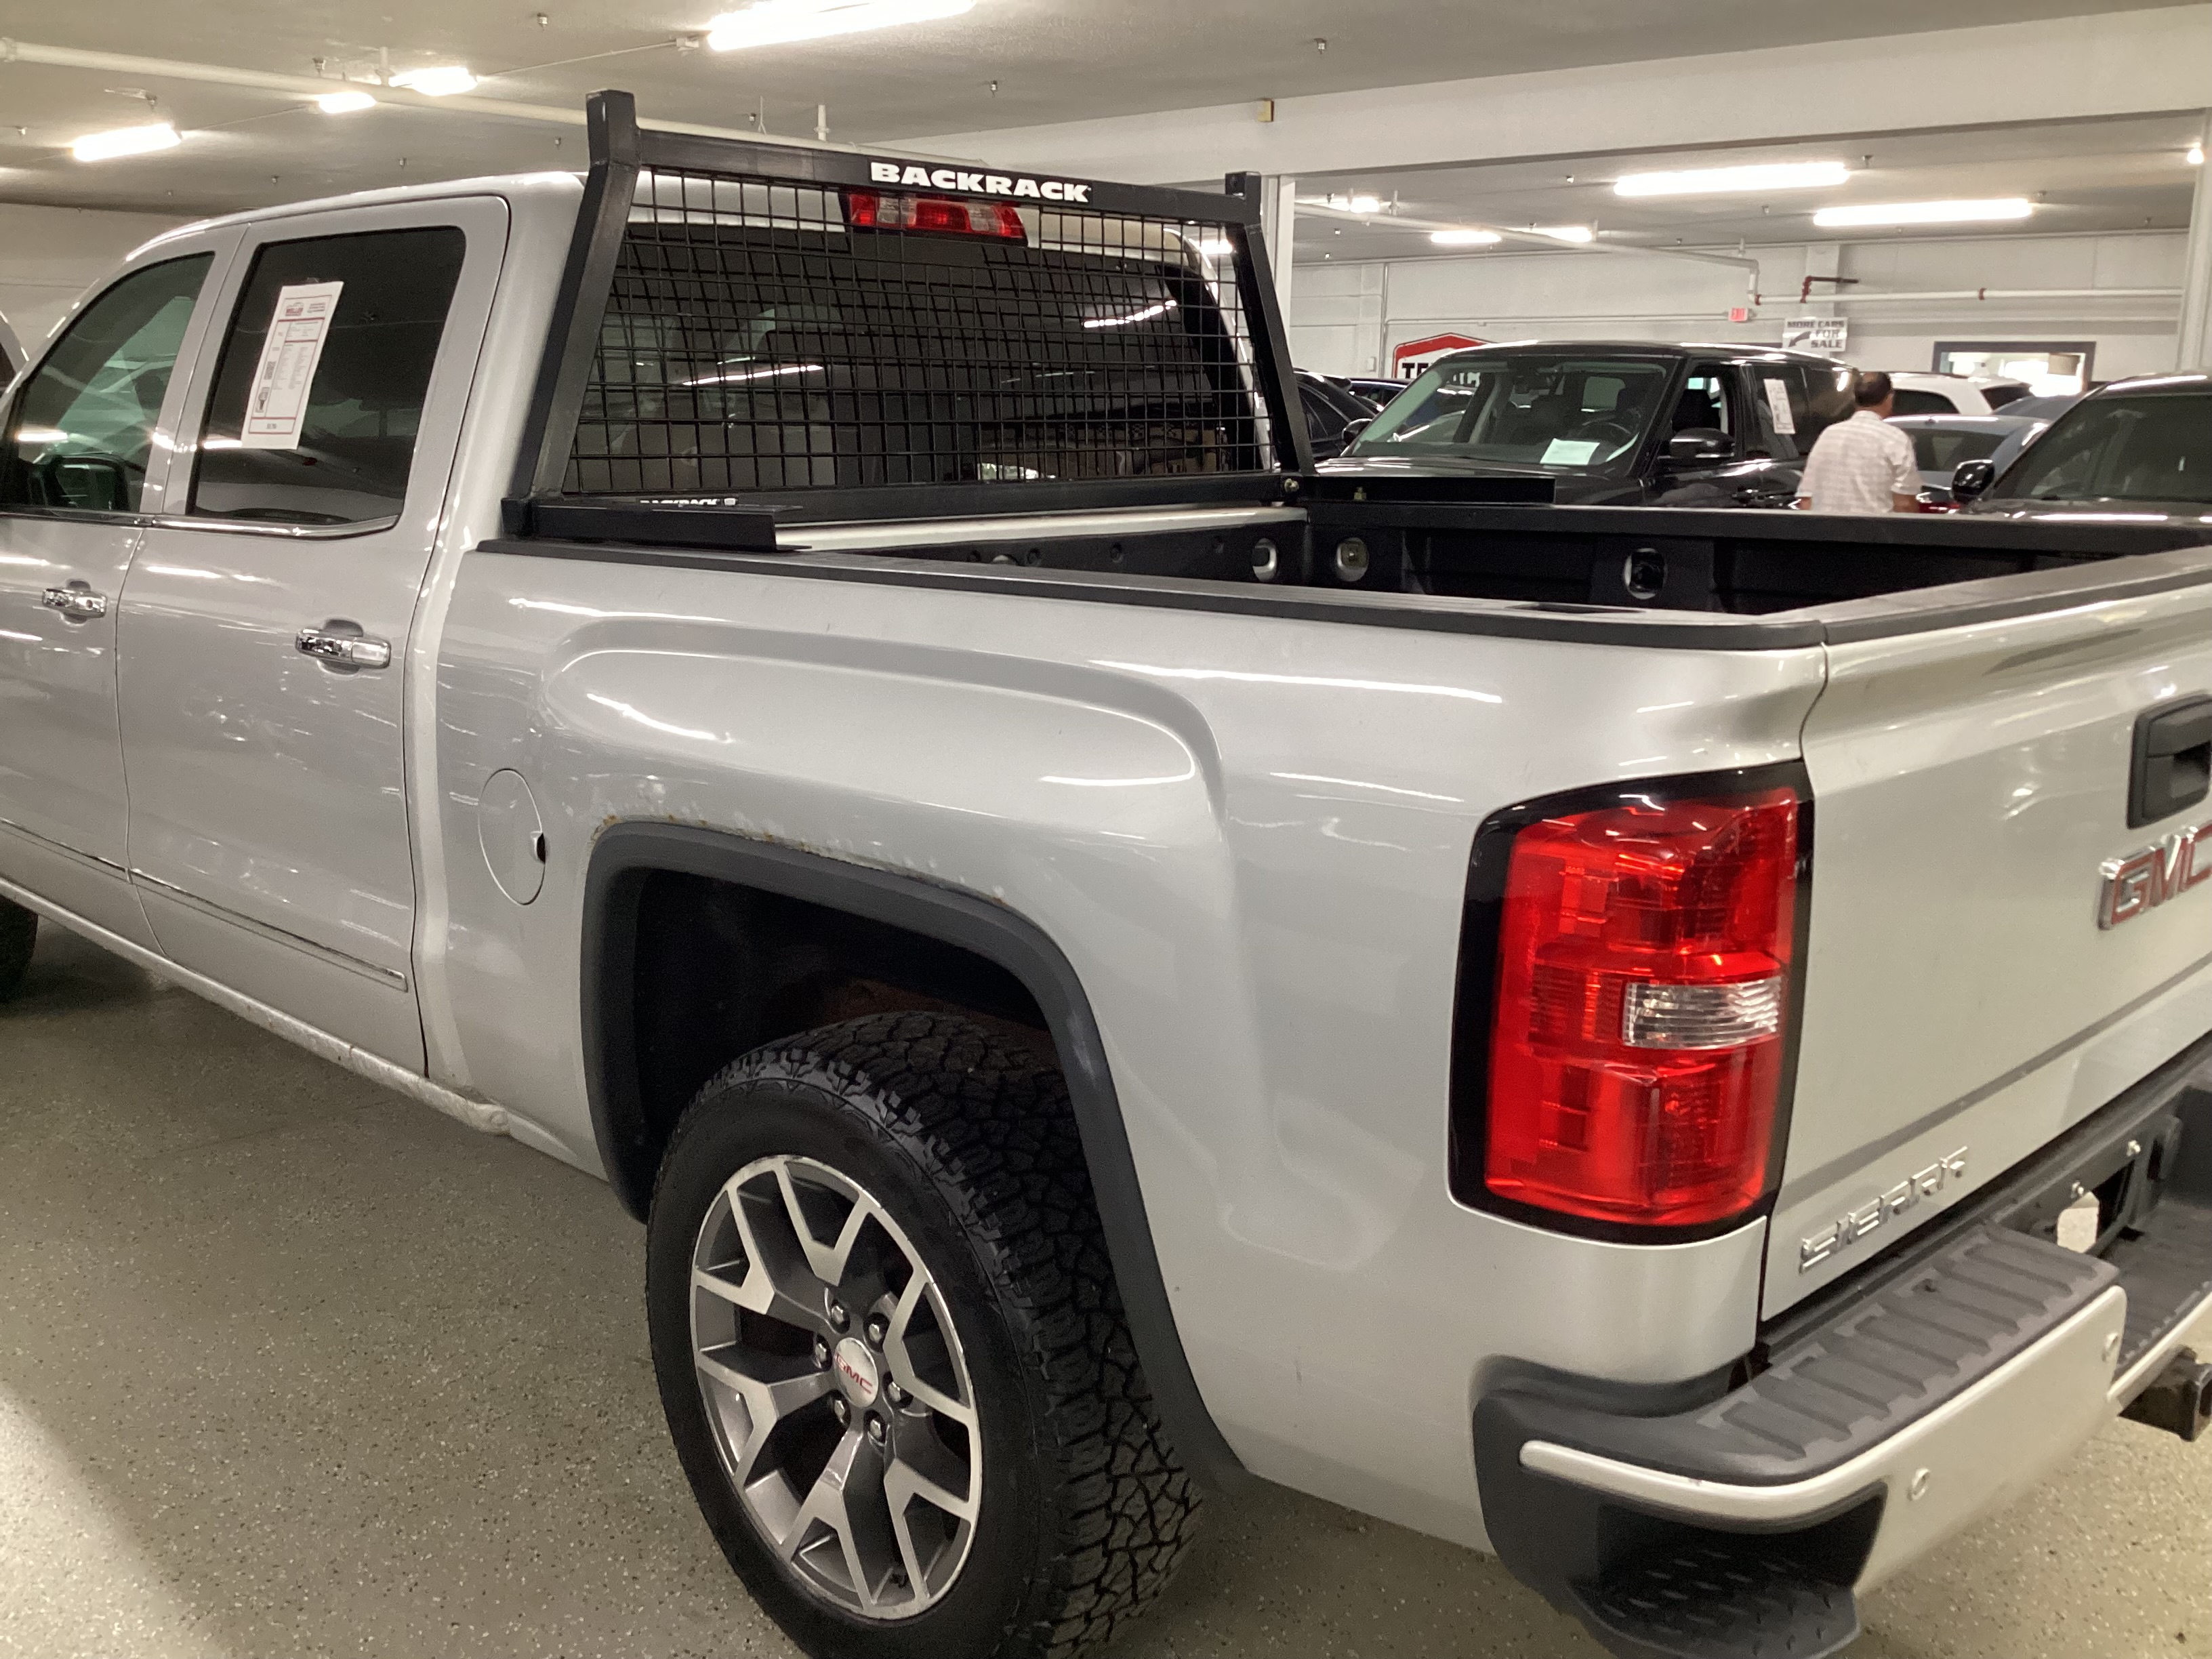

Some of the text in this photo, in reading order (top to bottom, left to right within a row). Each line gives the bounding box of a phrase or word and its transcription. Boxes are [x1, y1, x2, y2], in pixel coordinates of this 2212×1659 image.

[870, 161, 1088, 203] BACKRACK
[1810, 340, 1843, 348] SALE
[1815, 329, 1840, 338] FOR
[2098, 821, 2212, 930] GMC
[1799, 1146, 1968, 1275] SIERRA
[835, 1352, 873, 1395] GMC
